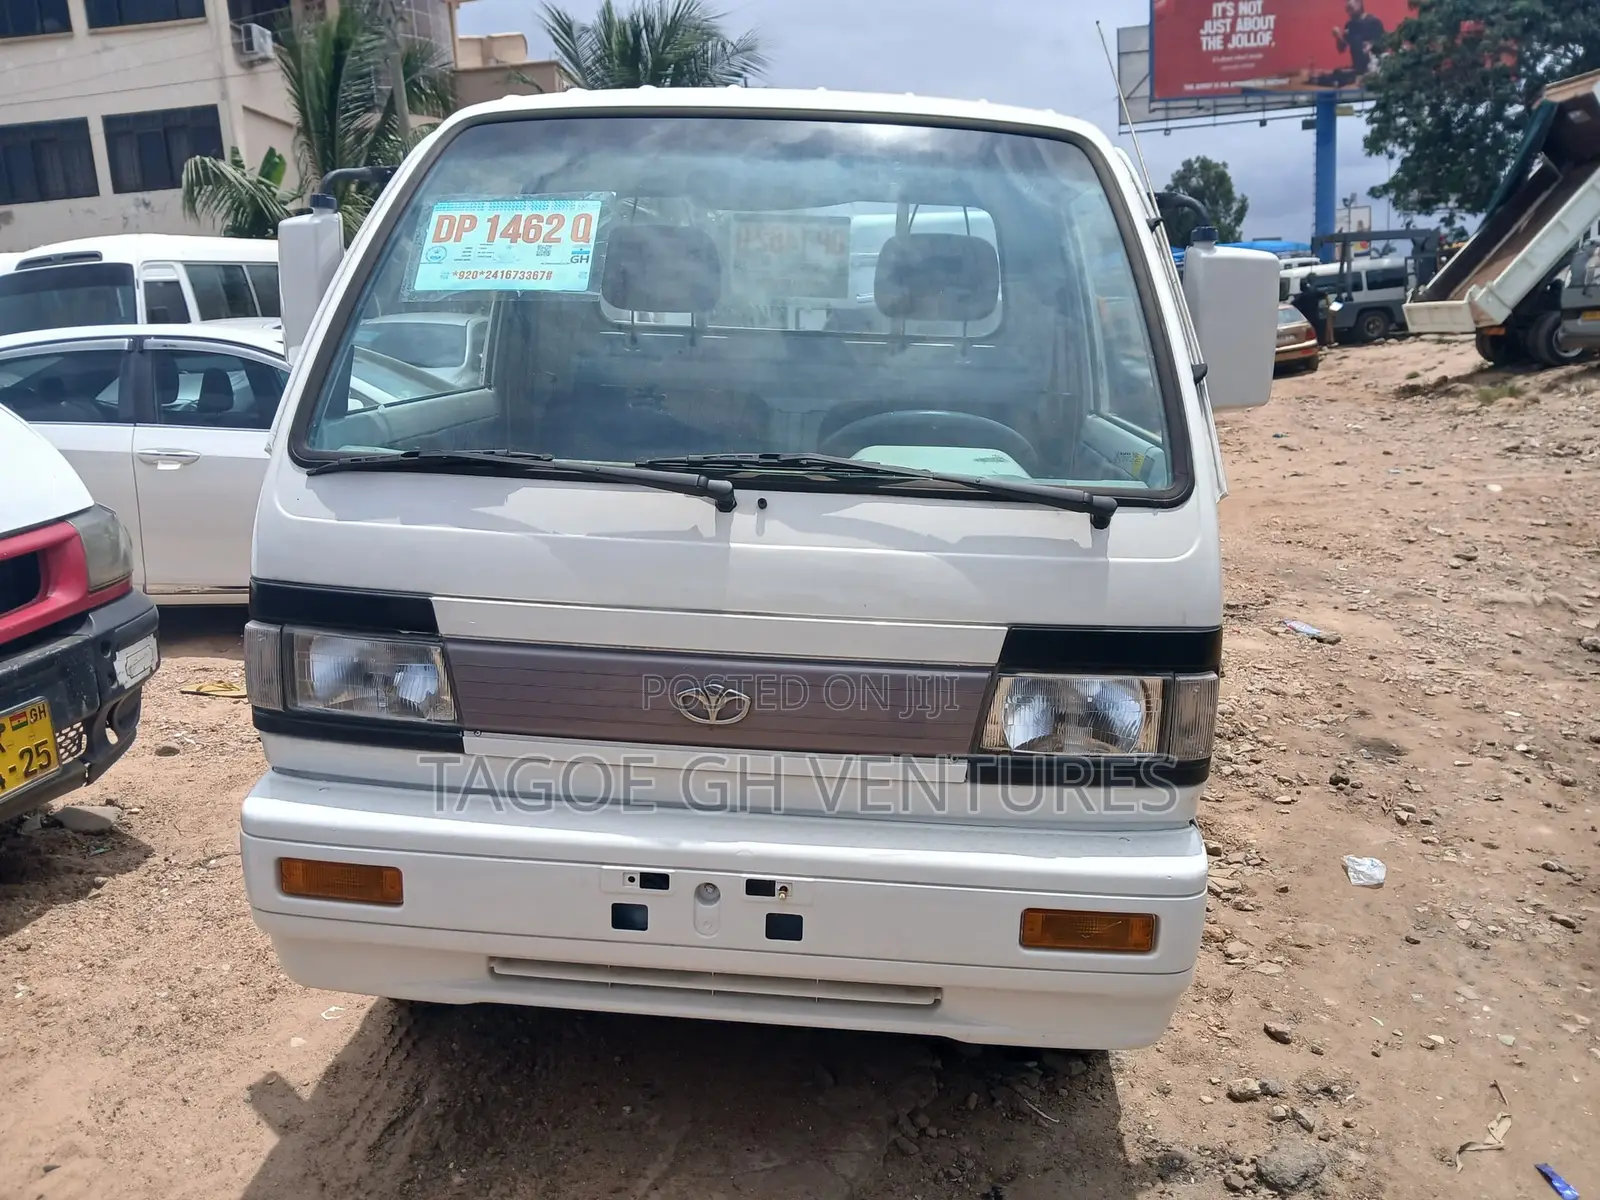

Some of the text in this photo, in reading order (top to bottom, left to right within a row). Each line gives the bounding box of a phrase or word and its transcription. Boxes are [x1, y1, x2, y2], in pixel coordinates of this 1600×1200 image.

[1212, 0, 1264, 17] IT'S NOT
[1200, 15, 1276, 35] JUST ABOUT
[1200, 35, 1224, 51] THE
[432, 213, 593, 244] DP 1462 Q
[570, 255, 590, 264] GH
[29, 704, 47, 724] GH
